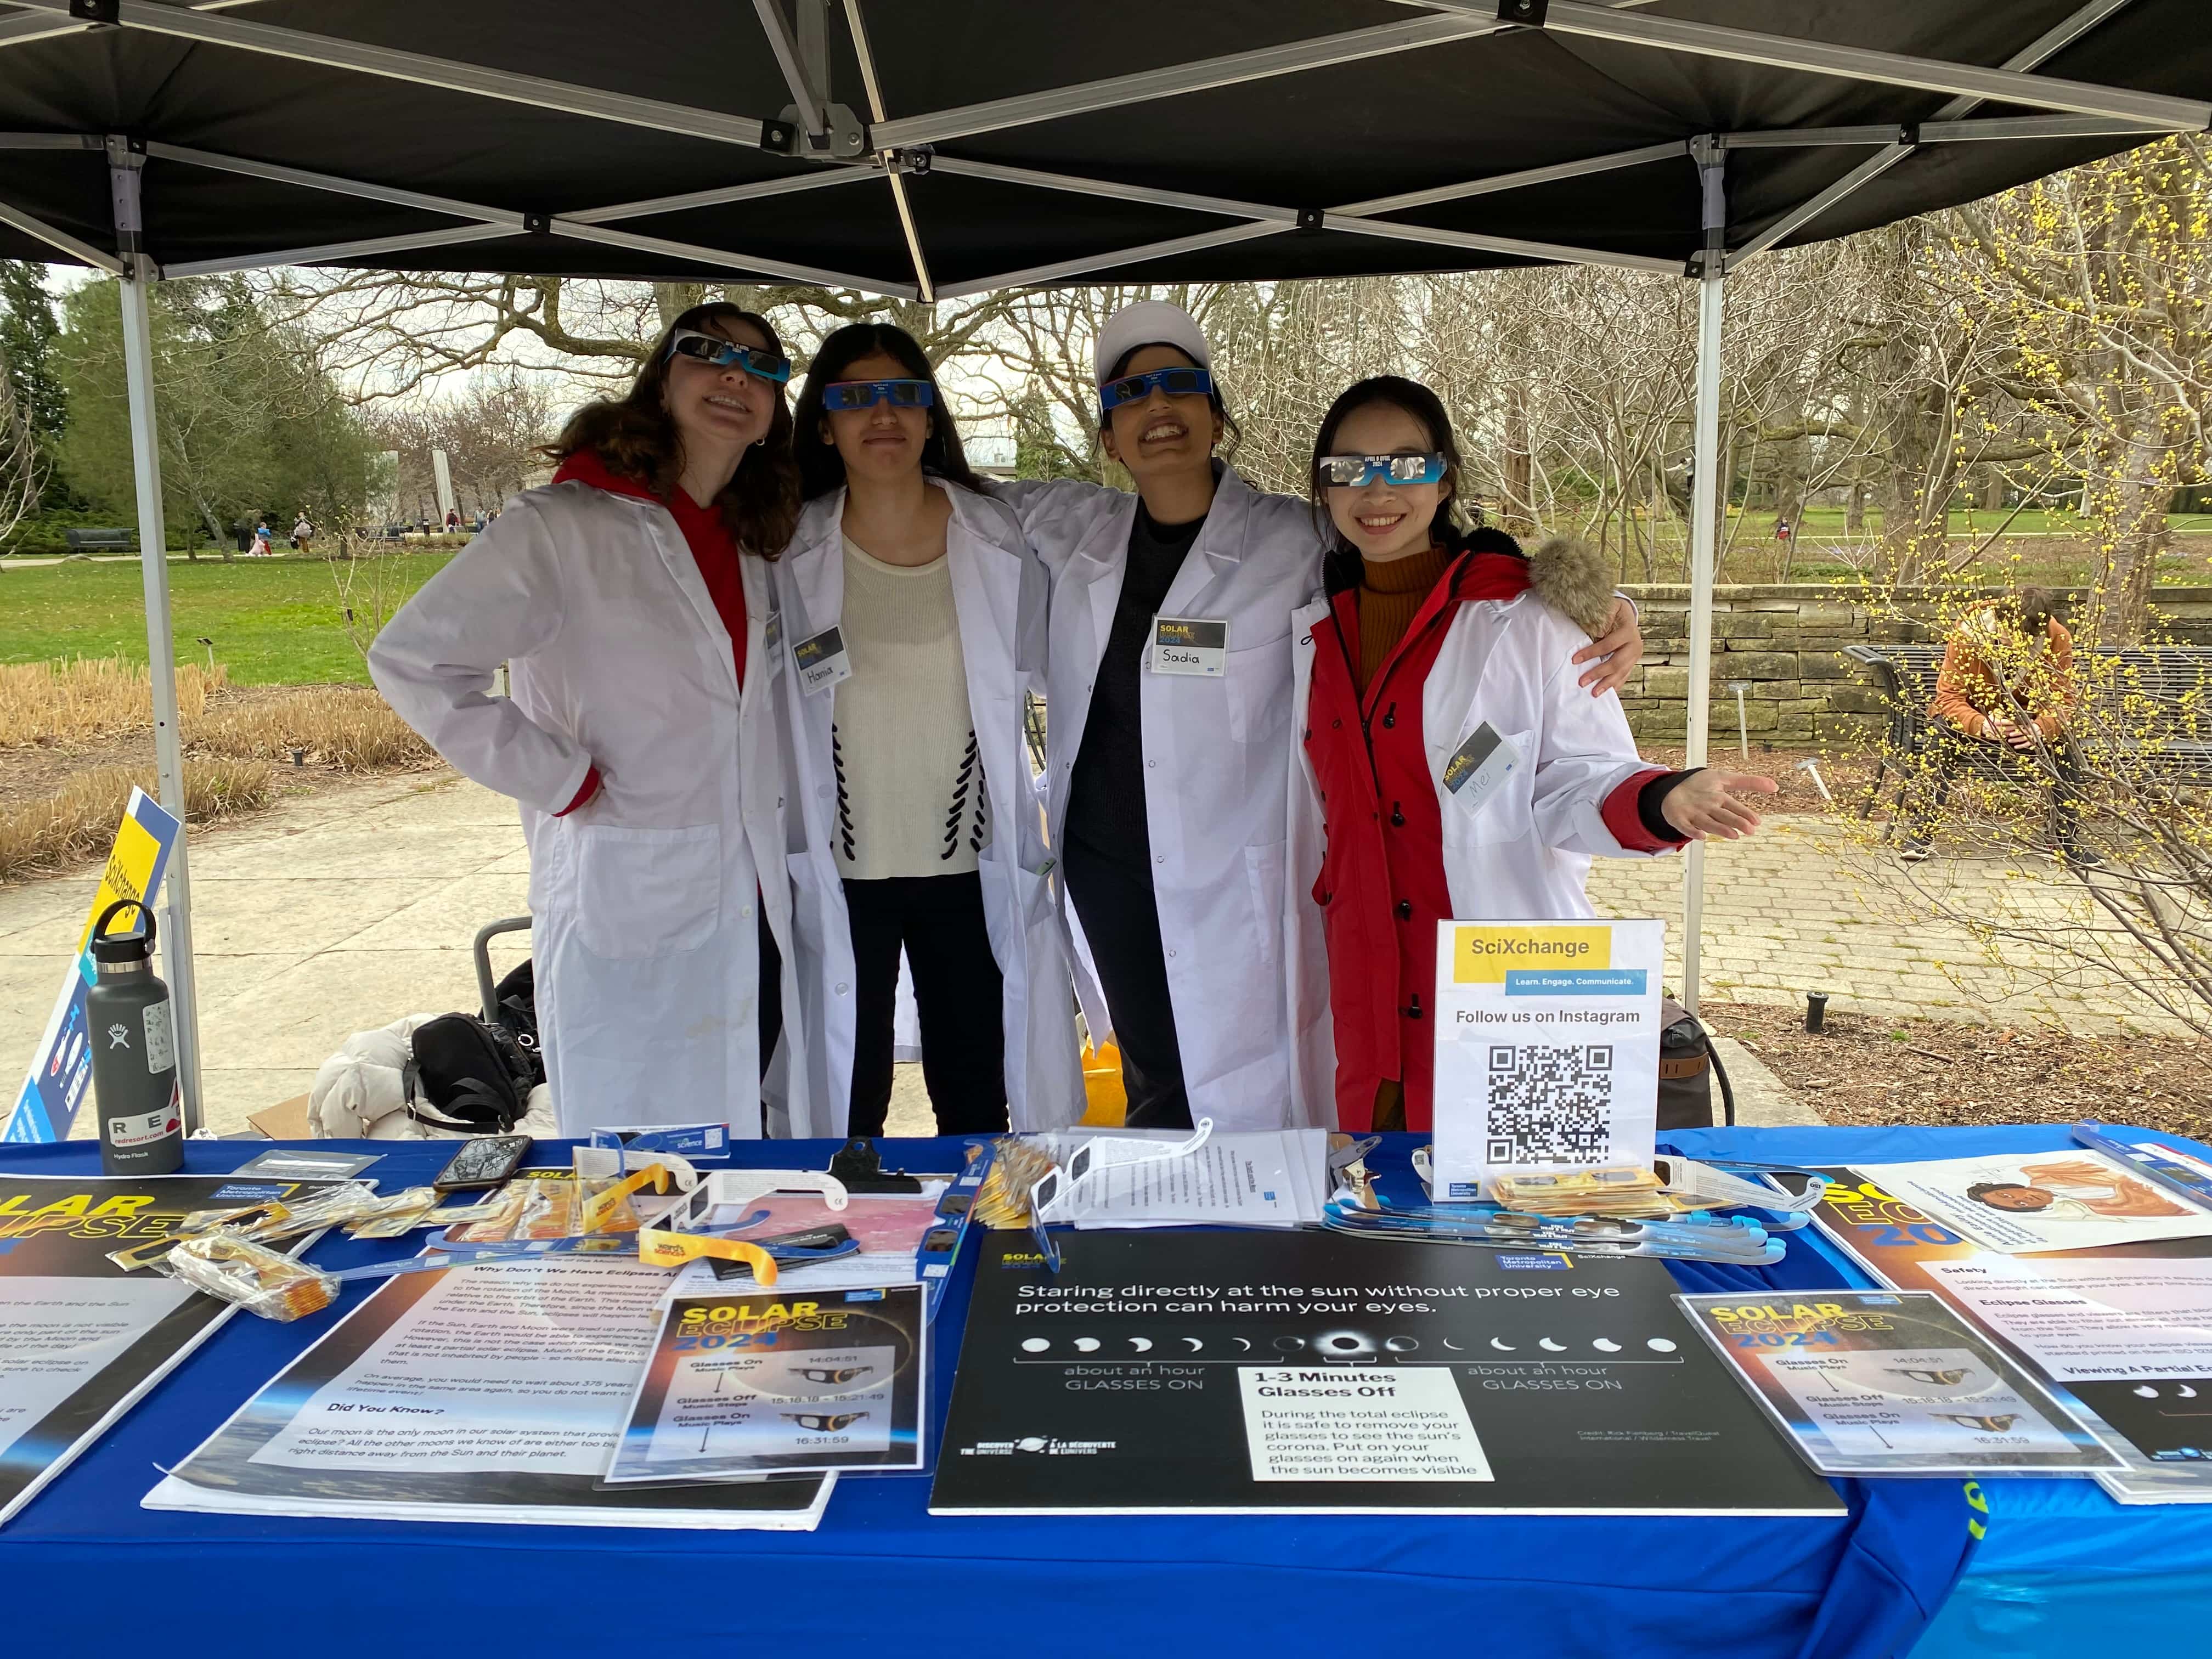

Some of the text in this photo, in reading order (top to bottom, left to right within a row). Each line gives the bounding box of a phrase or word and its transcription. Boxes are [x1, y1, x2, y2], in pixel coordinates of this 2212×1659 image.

[1163, 649, 1200, 664] Sadia
[1444, 755, 1467, 781] SOLAR
[1471, 939, 1589, 957] SciXchange
[1542, 978, 1574, 986] Engage.
[1457, 1010, 1639, 1025] Follow us on Instagram
[115, 1131, 163, 1144] redresort.com
[0, 1195, 155, 1216] LAR
[0, 1215, 187, 1238] IPSE
[1018, 1284, 1620, 1299] Staring directly at the sun without proper eye
[681, 1302, 820, 1324] SOLAR
[1015, 1300, 1436, 1314] protection can harm your eyes.
[1711, 1304, 1848, 1321] SOLAR
[676, 1313, 848, 1338] ECLIPSE
[1717, 1314, 1893, 1334] ECLIPSE
[673, 1332, 778, 1350] 2024
[1731, 1331, 1842, 1347] 2024
[1064, 1365, 1205, 1375] about an hour
[1468, 1364, 1607, 1375] about an hour
[2062, 1366, 2128, 1374] Viewing
[1255, 1372, 1396, 1382] 1-3 Minutes
[1065, 1379, 1203, 1390] GLASSES ON
[1482, 1380, 1622, 1390] GLASSES ON
[1258, 1386, 1396, 1396] Glasses Off
[327, 1403, 444, 1414] Did You Know?
[1261, 1410, 1314, 1419] During
[1391, 1410, 1447, 1419] eclipse
[397, 1429, 421, 1437] only
[1265, 1431, 1327, 1441] glasses
[1418, 1431, 1460, 1440] sun's
[1333, 1442, 1361, 1451] Put
[1269, 1454, 1332, 1463] glasses
[1363, 1454, 1408, 1463] again
[1338, 1465, 1418, 1474] becomes
[1421, 1465, 1476, 1474] visible
